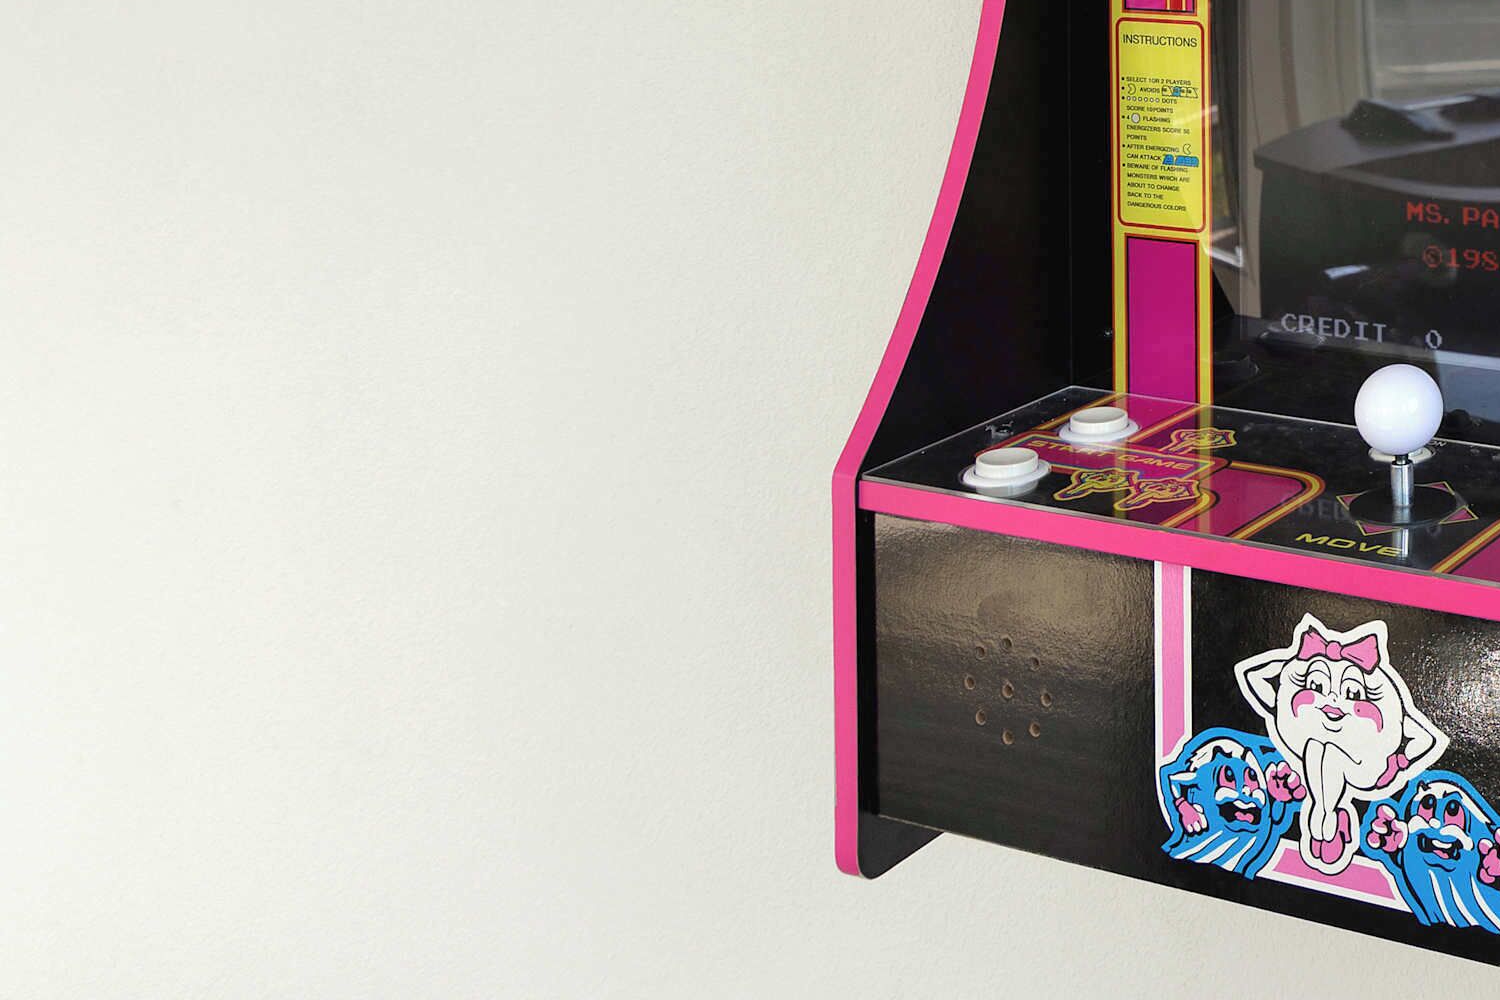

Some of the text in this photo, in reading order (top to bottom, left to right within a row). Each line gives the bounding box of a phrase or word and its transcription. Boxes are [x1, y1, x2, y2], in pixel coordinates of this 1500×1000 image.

[1122, 33, 1198, 48] INSTRUCTIONS
[1165, 78, 1192, 86] PLAYERS
[1127, 172, 1158, 180] MONSTERS
[1127, 201, 1187, 211] DANGEROUS COLORS
[1406, 202, 1450, 225] MS.
[1281, 312, 1387, 343] CREDIT
[1028, 439, 1195, 471] START GAME
[1295, 532, 1404, 558] MOVE
